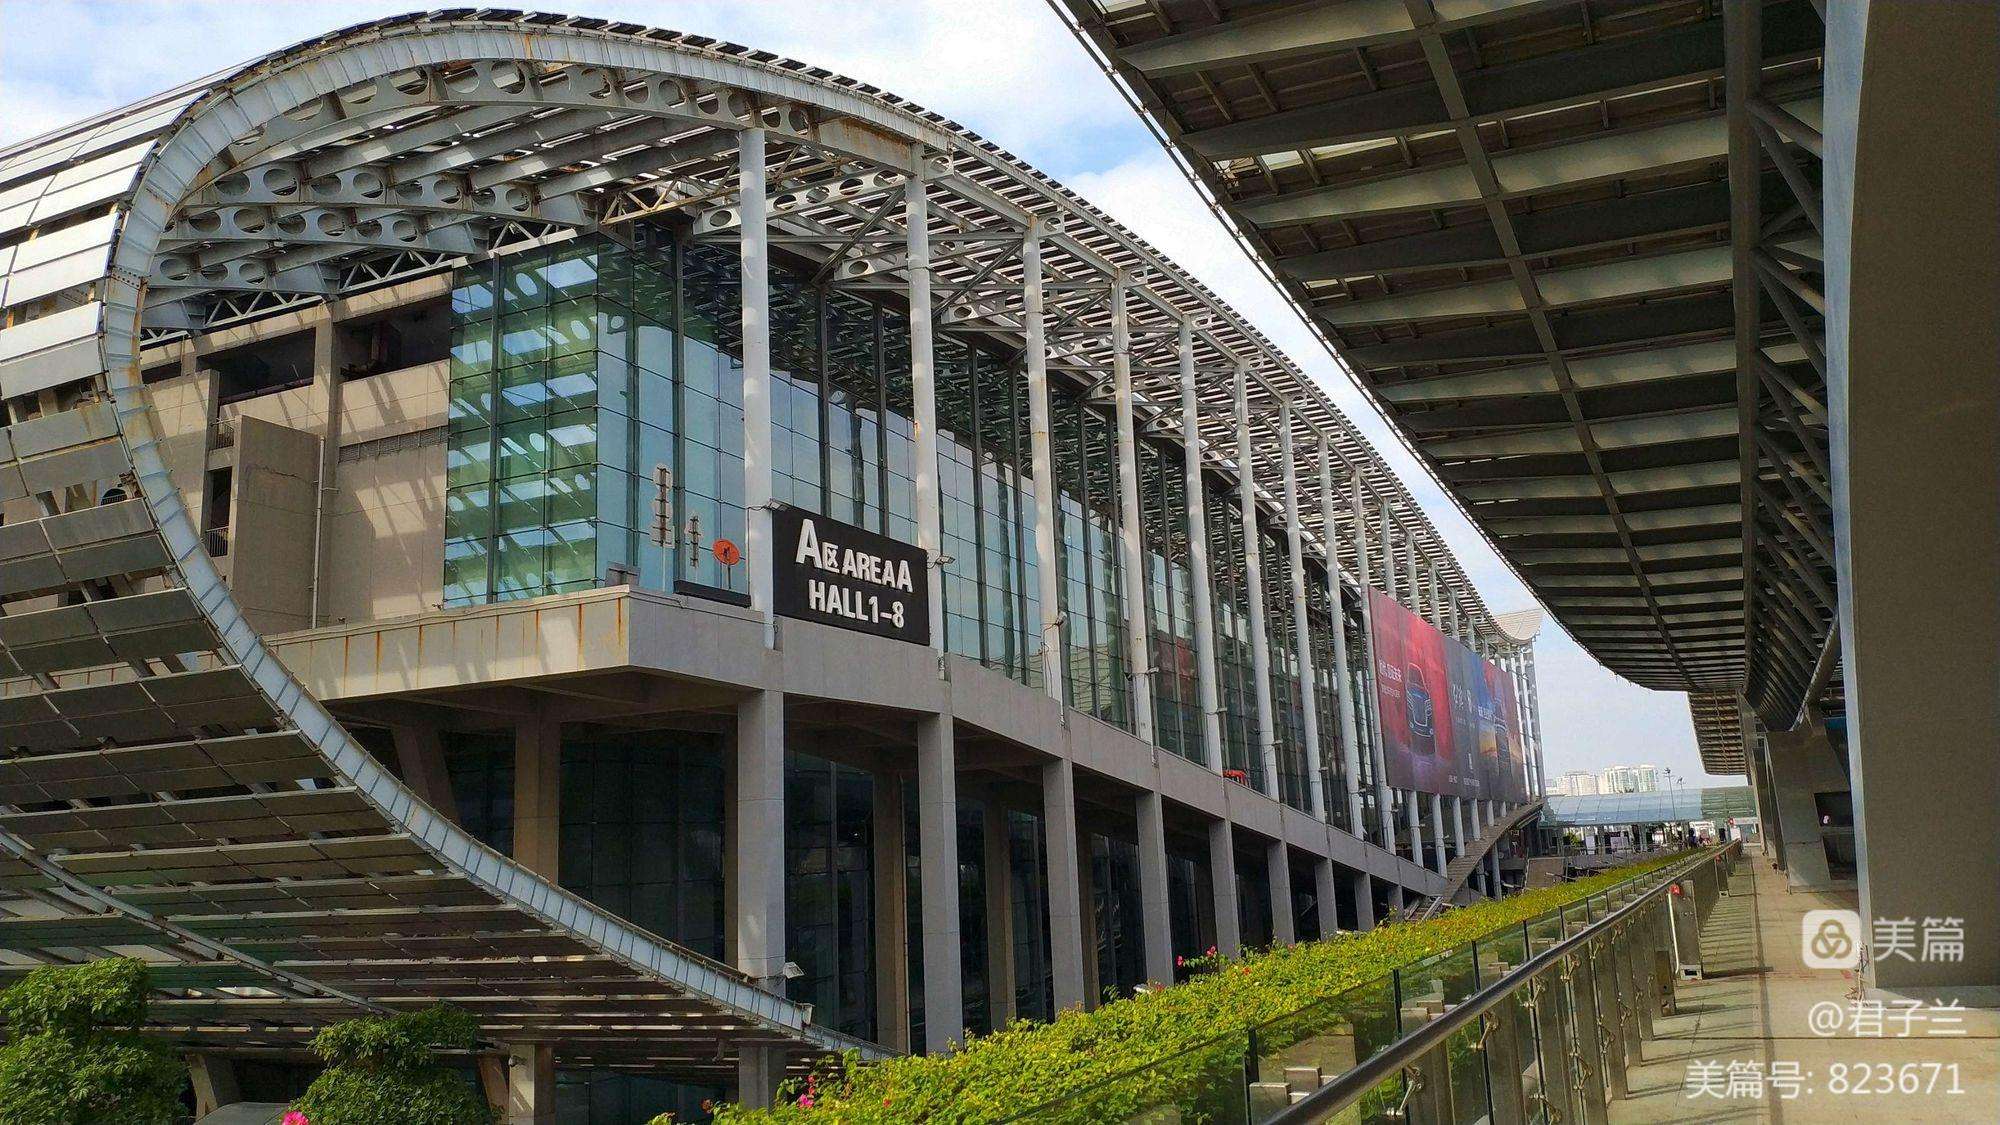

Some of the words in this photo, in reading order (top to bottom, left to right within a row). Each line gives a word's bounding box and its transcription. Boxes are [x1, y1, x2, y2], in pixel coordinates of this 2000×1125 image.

[841, 548, 896, 588] AREA
[808, 579, 869, 621] HALL
[868, 596, 904, 628] 1-8
